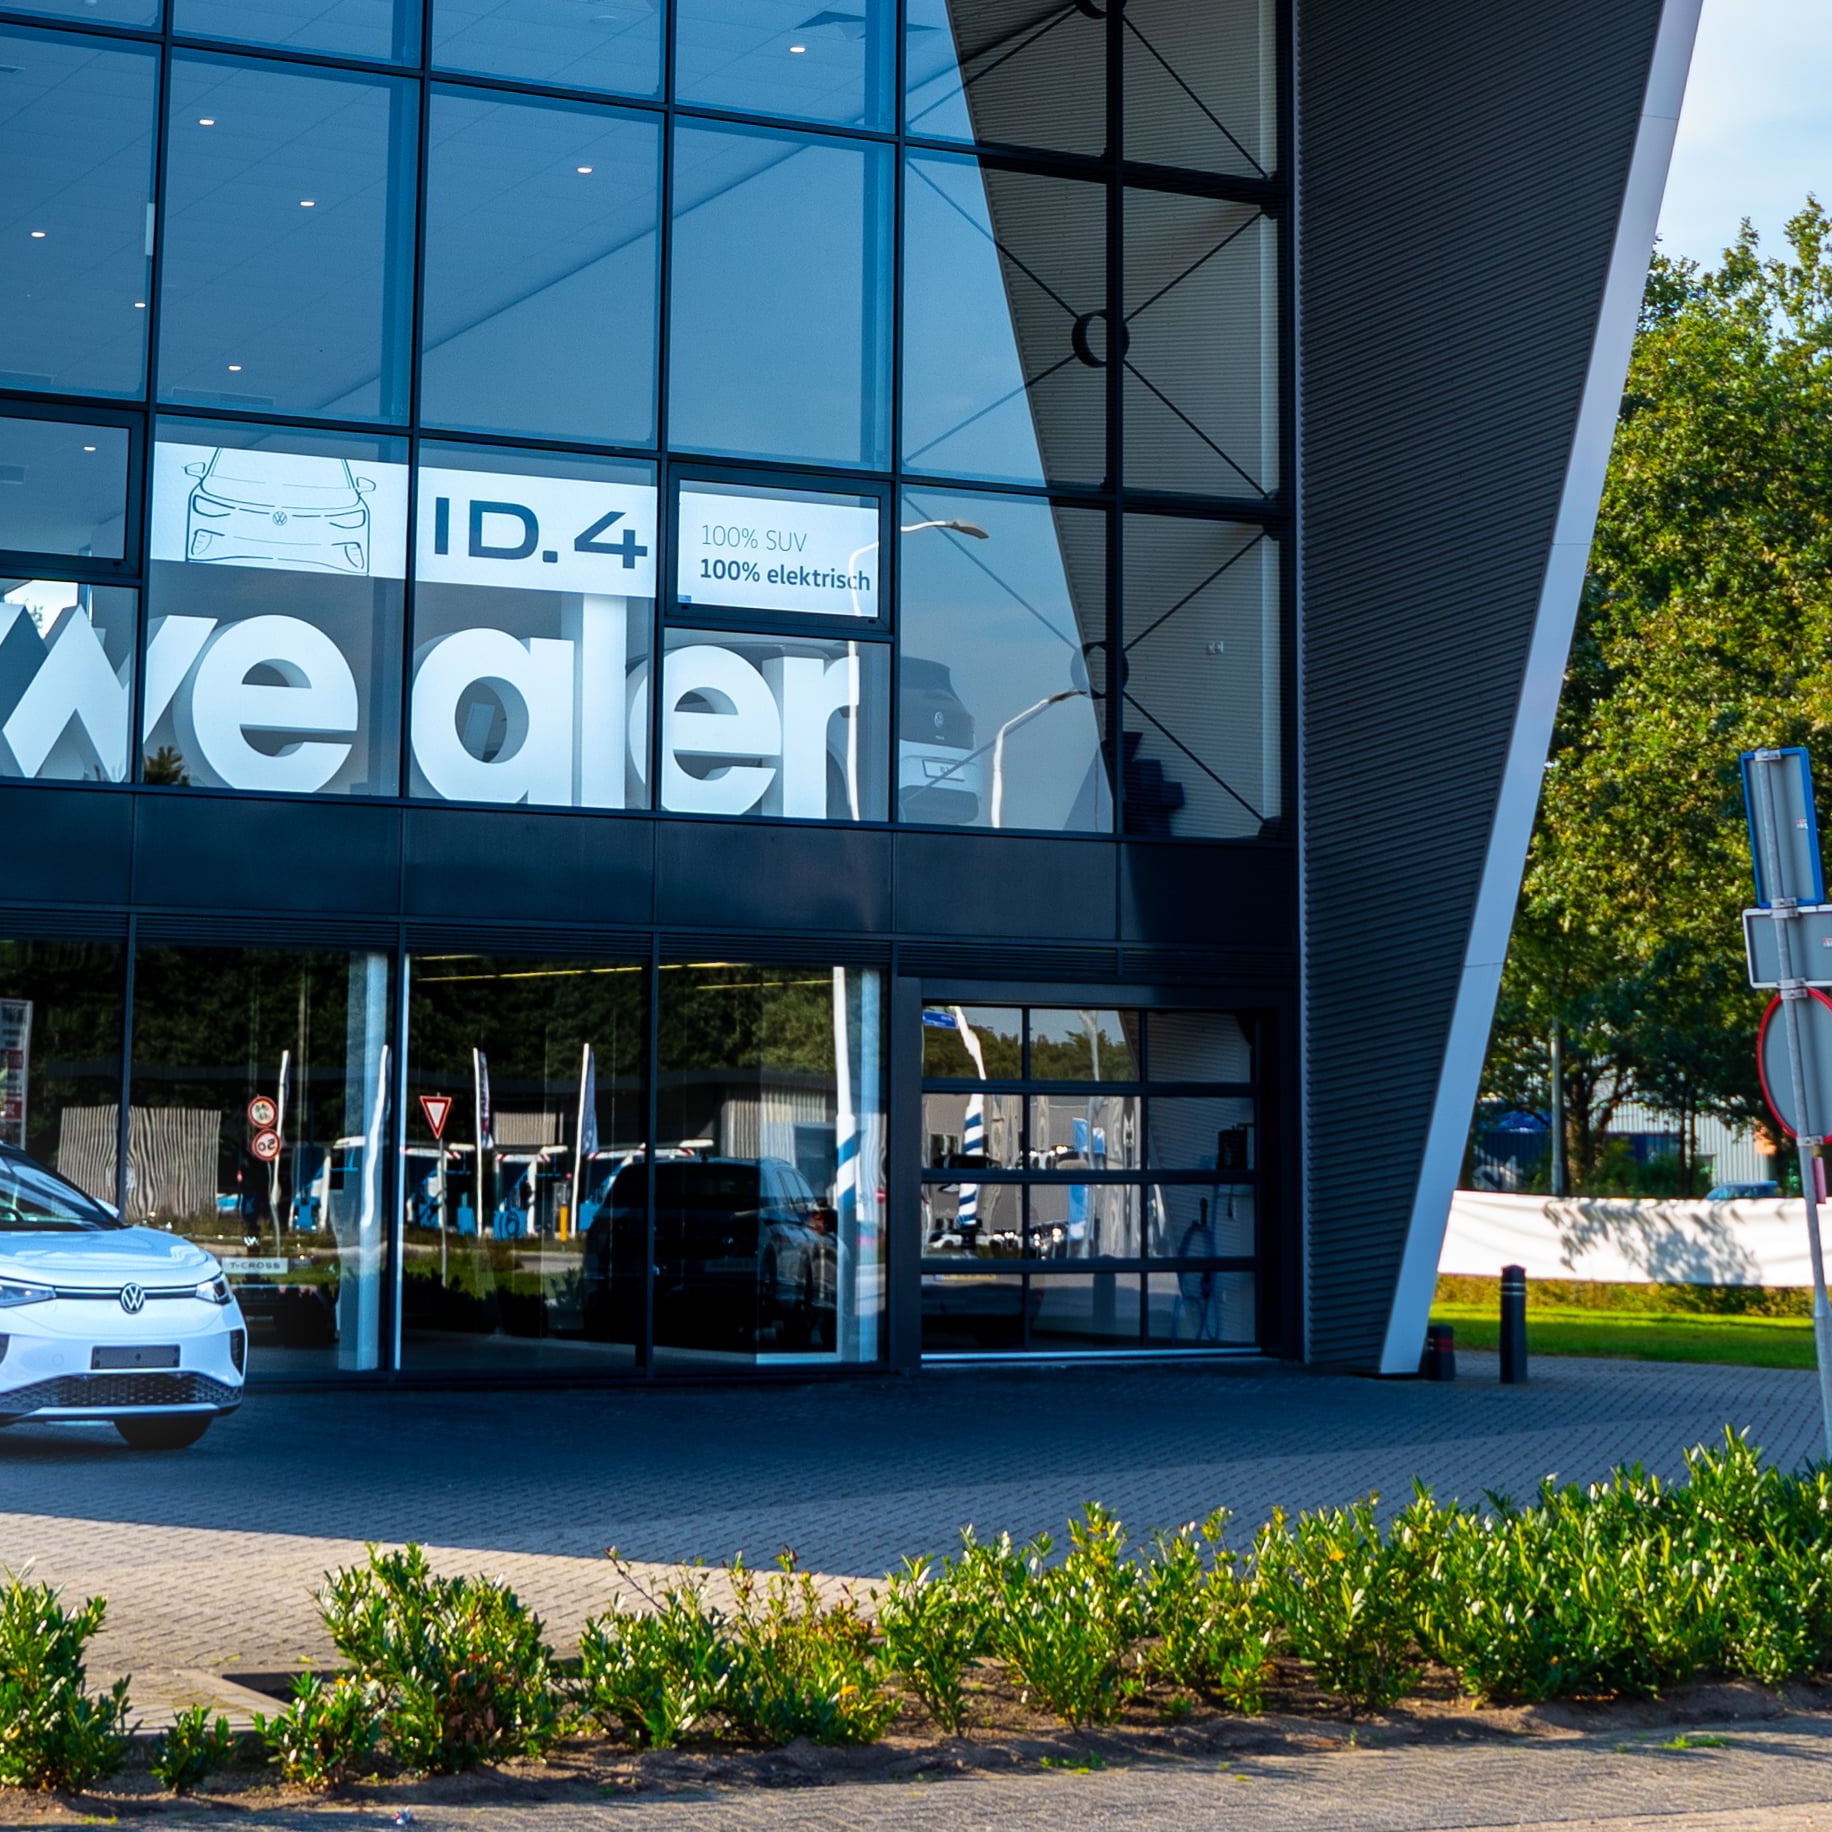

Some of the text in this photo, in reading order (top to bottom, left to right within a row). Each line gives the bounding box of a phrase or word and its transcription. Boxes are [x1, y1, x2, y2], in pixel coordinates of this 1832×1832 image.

[434, 496, 648, 570] ID.4
[701, 524, 807, 552] 100% SUV
[700, 558, 871, 591] 100% elektrisch
